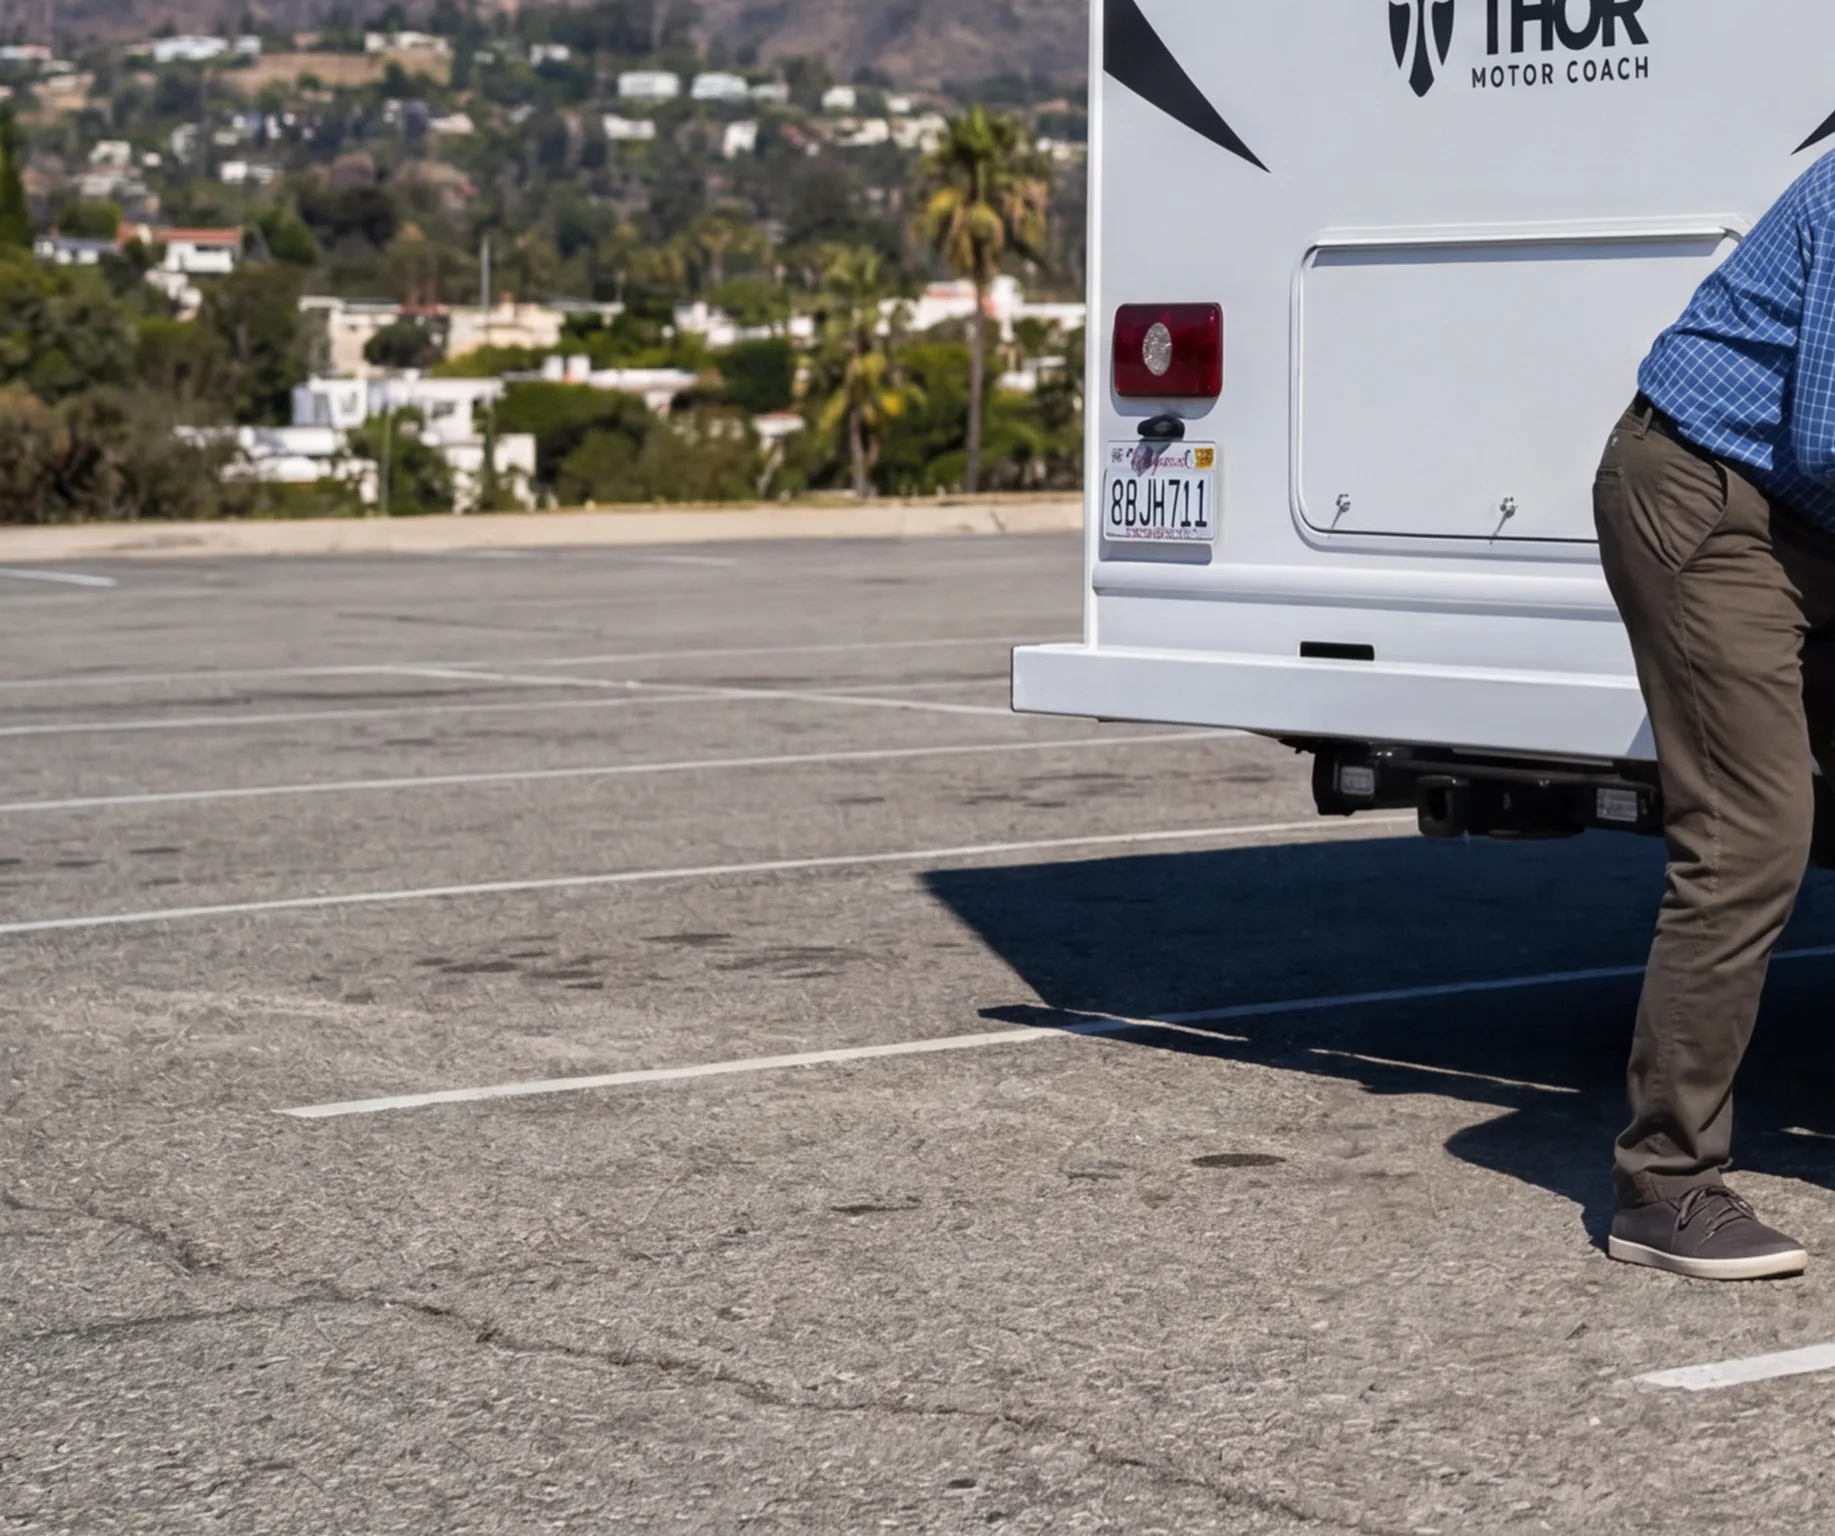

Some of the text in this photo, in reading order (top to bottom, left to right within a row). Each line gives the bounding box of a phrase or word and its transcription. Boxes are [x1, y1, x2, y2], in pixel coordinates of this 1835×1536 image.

[1471, 56, 1649, 88] MOTOR COACH
[1110, 478, 1208, 528] 8BJH711
